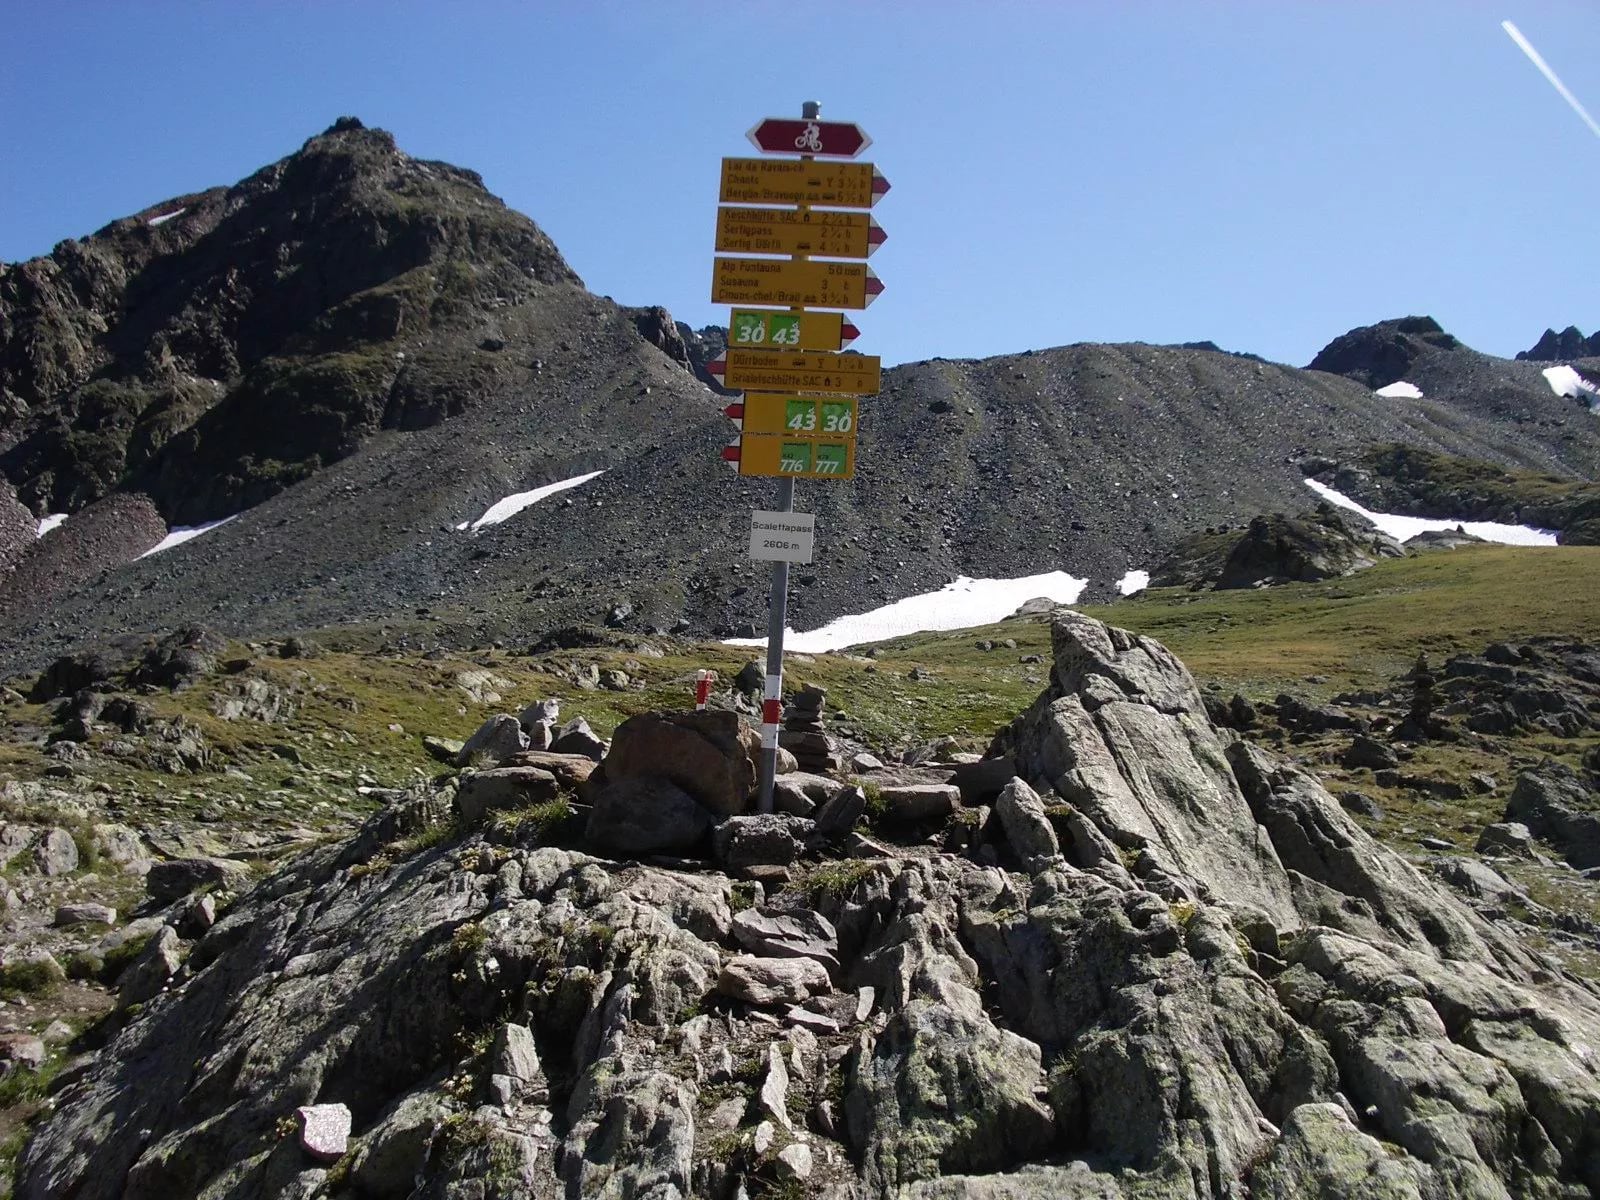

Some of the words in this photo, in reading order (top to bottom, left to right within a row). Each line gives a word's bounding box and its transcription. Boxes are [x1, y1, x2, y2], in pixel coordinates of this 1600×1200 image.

[721, 262, 735, 272] Alp
[720, 277, 759, 287] Susauna
[737, 325, 765, 343] 30
[772, 327, 800, 345] 43
[802, 376, 820, 386] SAC
[788, 414, 816, 431] 43
[823, 415, 851, 432] 30
[780, 459, 803, 472] 776
[815, 461, 839, 474] 777
[752, 522, 812, 533] Scalettapass
[763, 540, 789, 549] 2606
